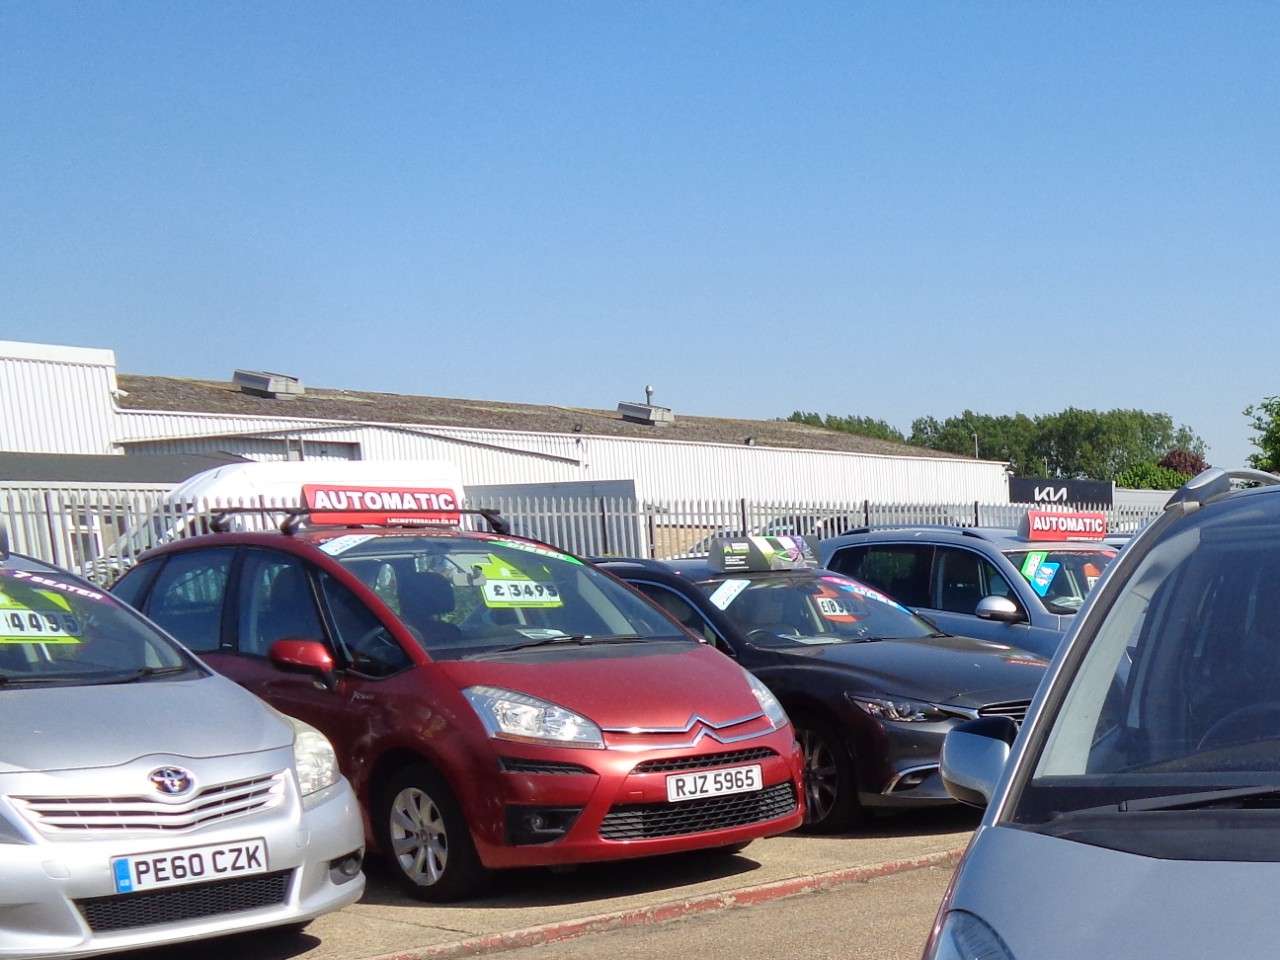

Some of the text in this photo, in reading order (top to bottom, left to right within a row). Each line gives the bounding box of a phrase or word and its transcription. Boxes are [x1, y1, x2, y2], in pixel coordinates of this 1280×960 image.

[313, 490, 456, 511] AUTOMATIC
[1034, 486, 1068, 502] KIA
[1033, 516, 1103, 532] AUTOMATIC
[30, 576, 103, 600] SEATER
[675, 769, 755, 797] RJZ 5965
[134, 845, 262, 885] PE60 CZK
